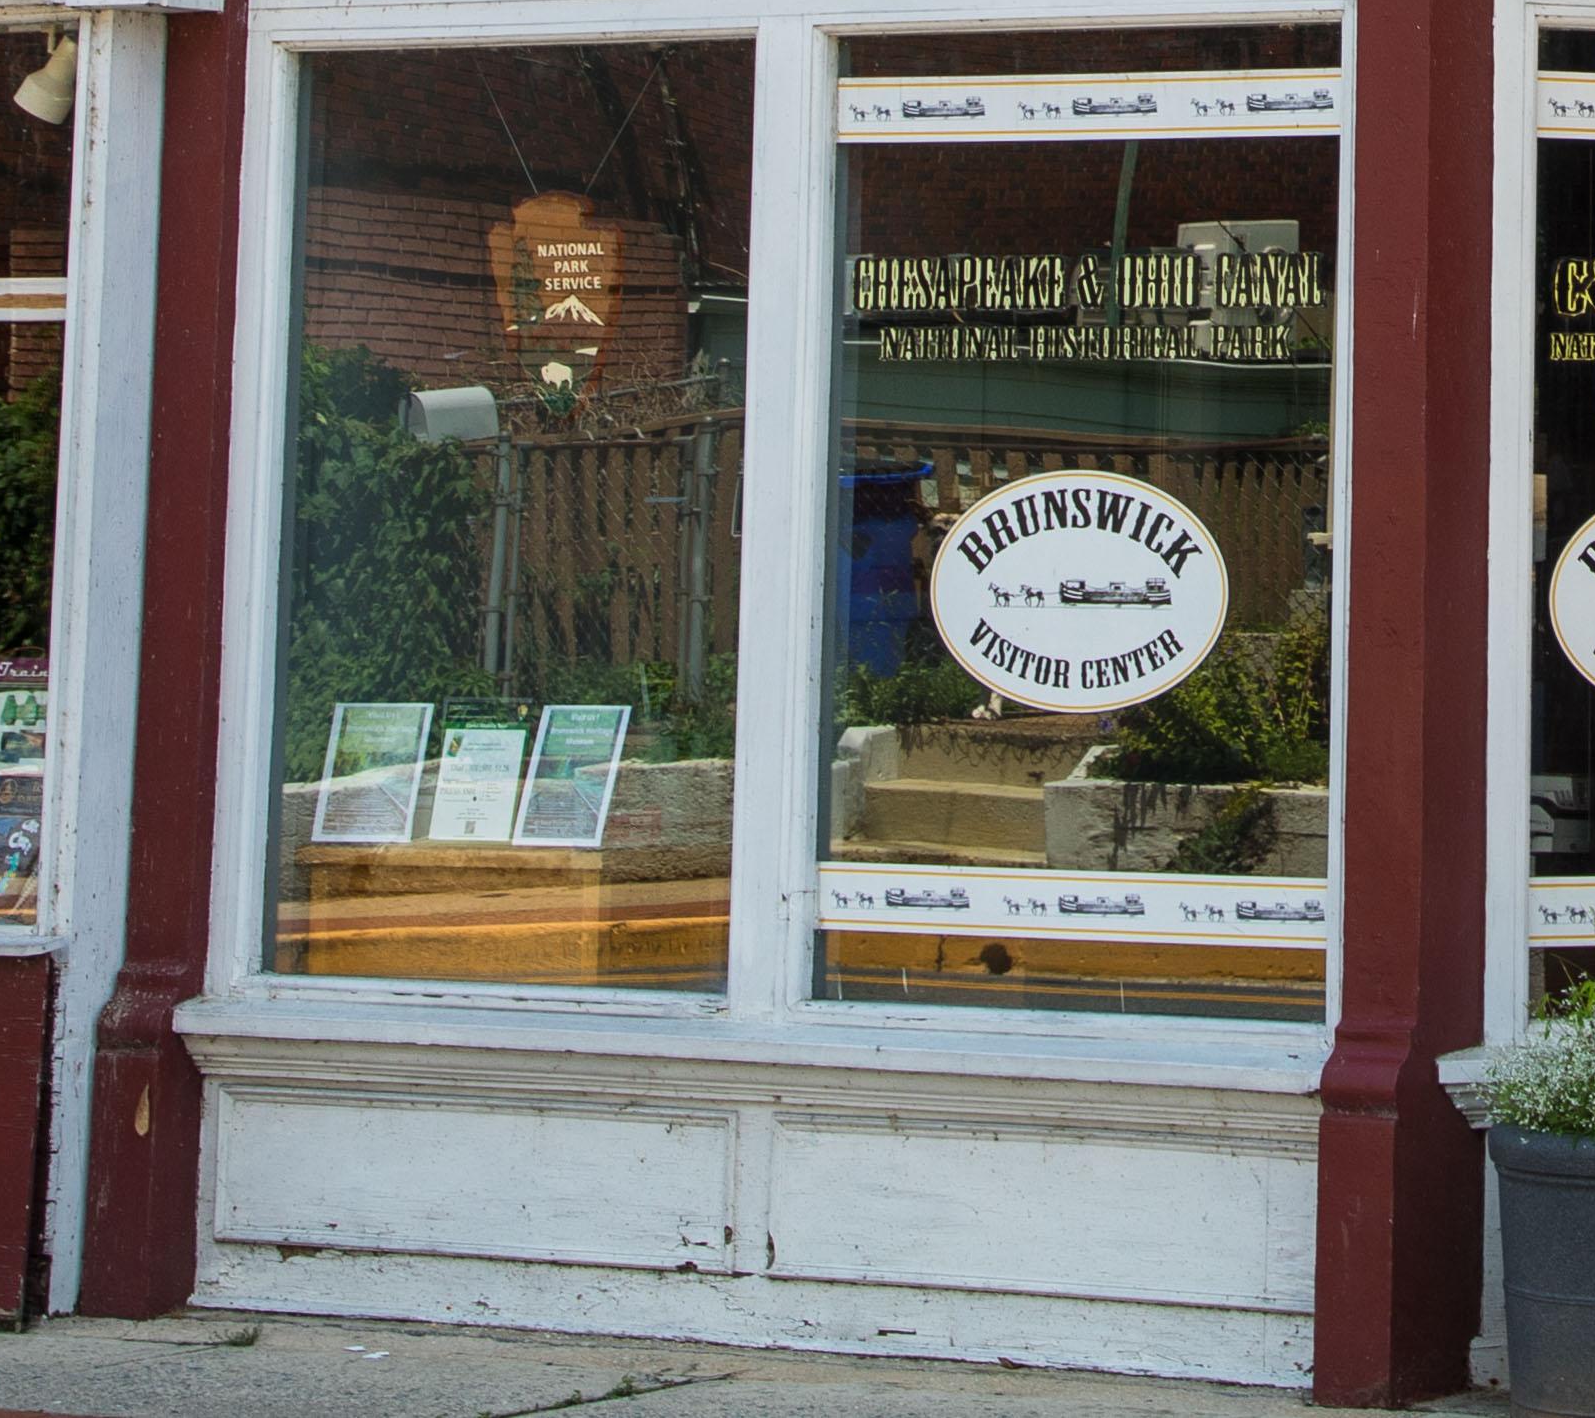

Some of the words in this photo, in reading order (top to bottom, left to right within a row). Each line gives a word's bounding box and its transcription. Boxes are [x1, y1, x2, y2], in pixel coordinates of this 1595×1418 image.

[537, 242, 605, 258] NATIONAL
[553, 260, 589, 273] PARK
[544, 276, 602, 291] SERVICE
[853, 255, 1066, 310] CHESAPEAKE
[1078, 254, 1103, 310] &
[1118, 253, 1202, 310] OHIO
[1215, 252, 1325, 309] CANAL
[879, 326, 1019, 361] NATIONAL
[1028, 325, 1200, 361] HISTORICAL
[1210, 325, 1290, 360] PARK
[956, 488, 1203, 579] BRUNSWICK
[969, 618, 1070, 689] VISITOR
[1081, 629, 1184, 690] CENTER
